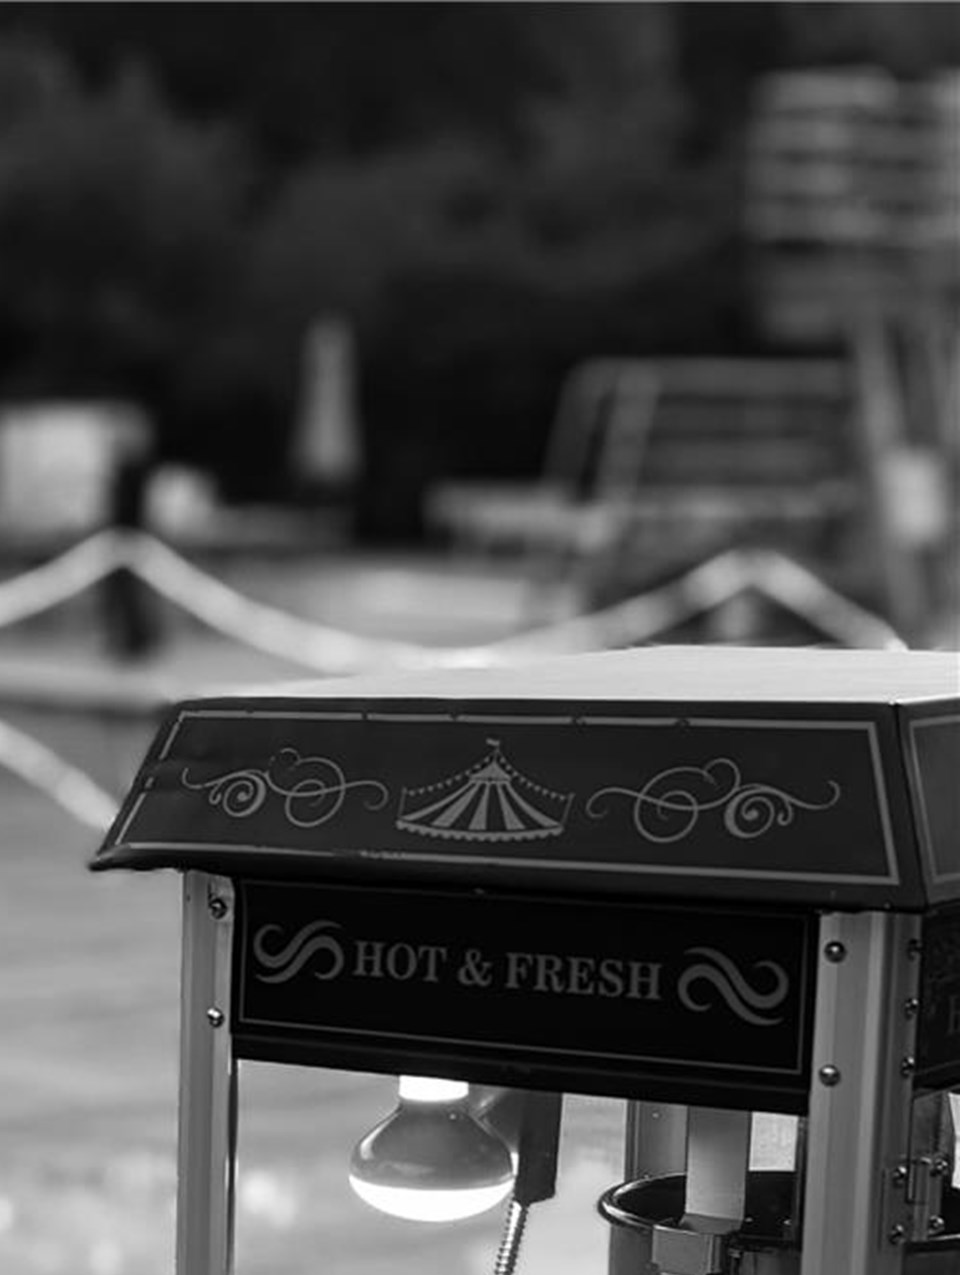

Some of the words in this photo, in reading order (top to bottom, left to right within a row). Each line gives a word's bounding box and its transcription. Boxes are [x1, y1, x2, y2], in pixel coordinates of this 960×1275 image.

[352, 940, 448, 982] HOT
[458, 949, 493, 987] &
[505, 952, 663, 1000] FRESH
